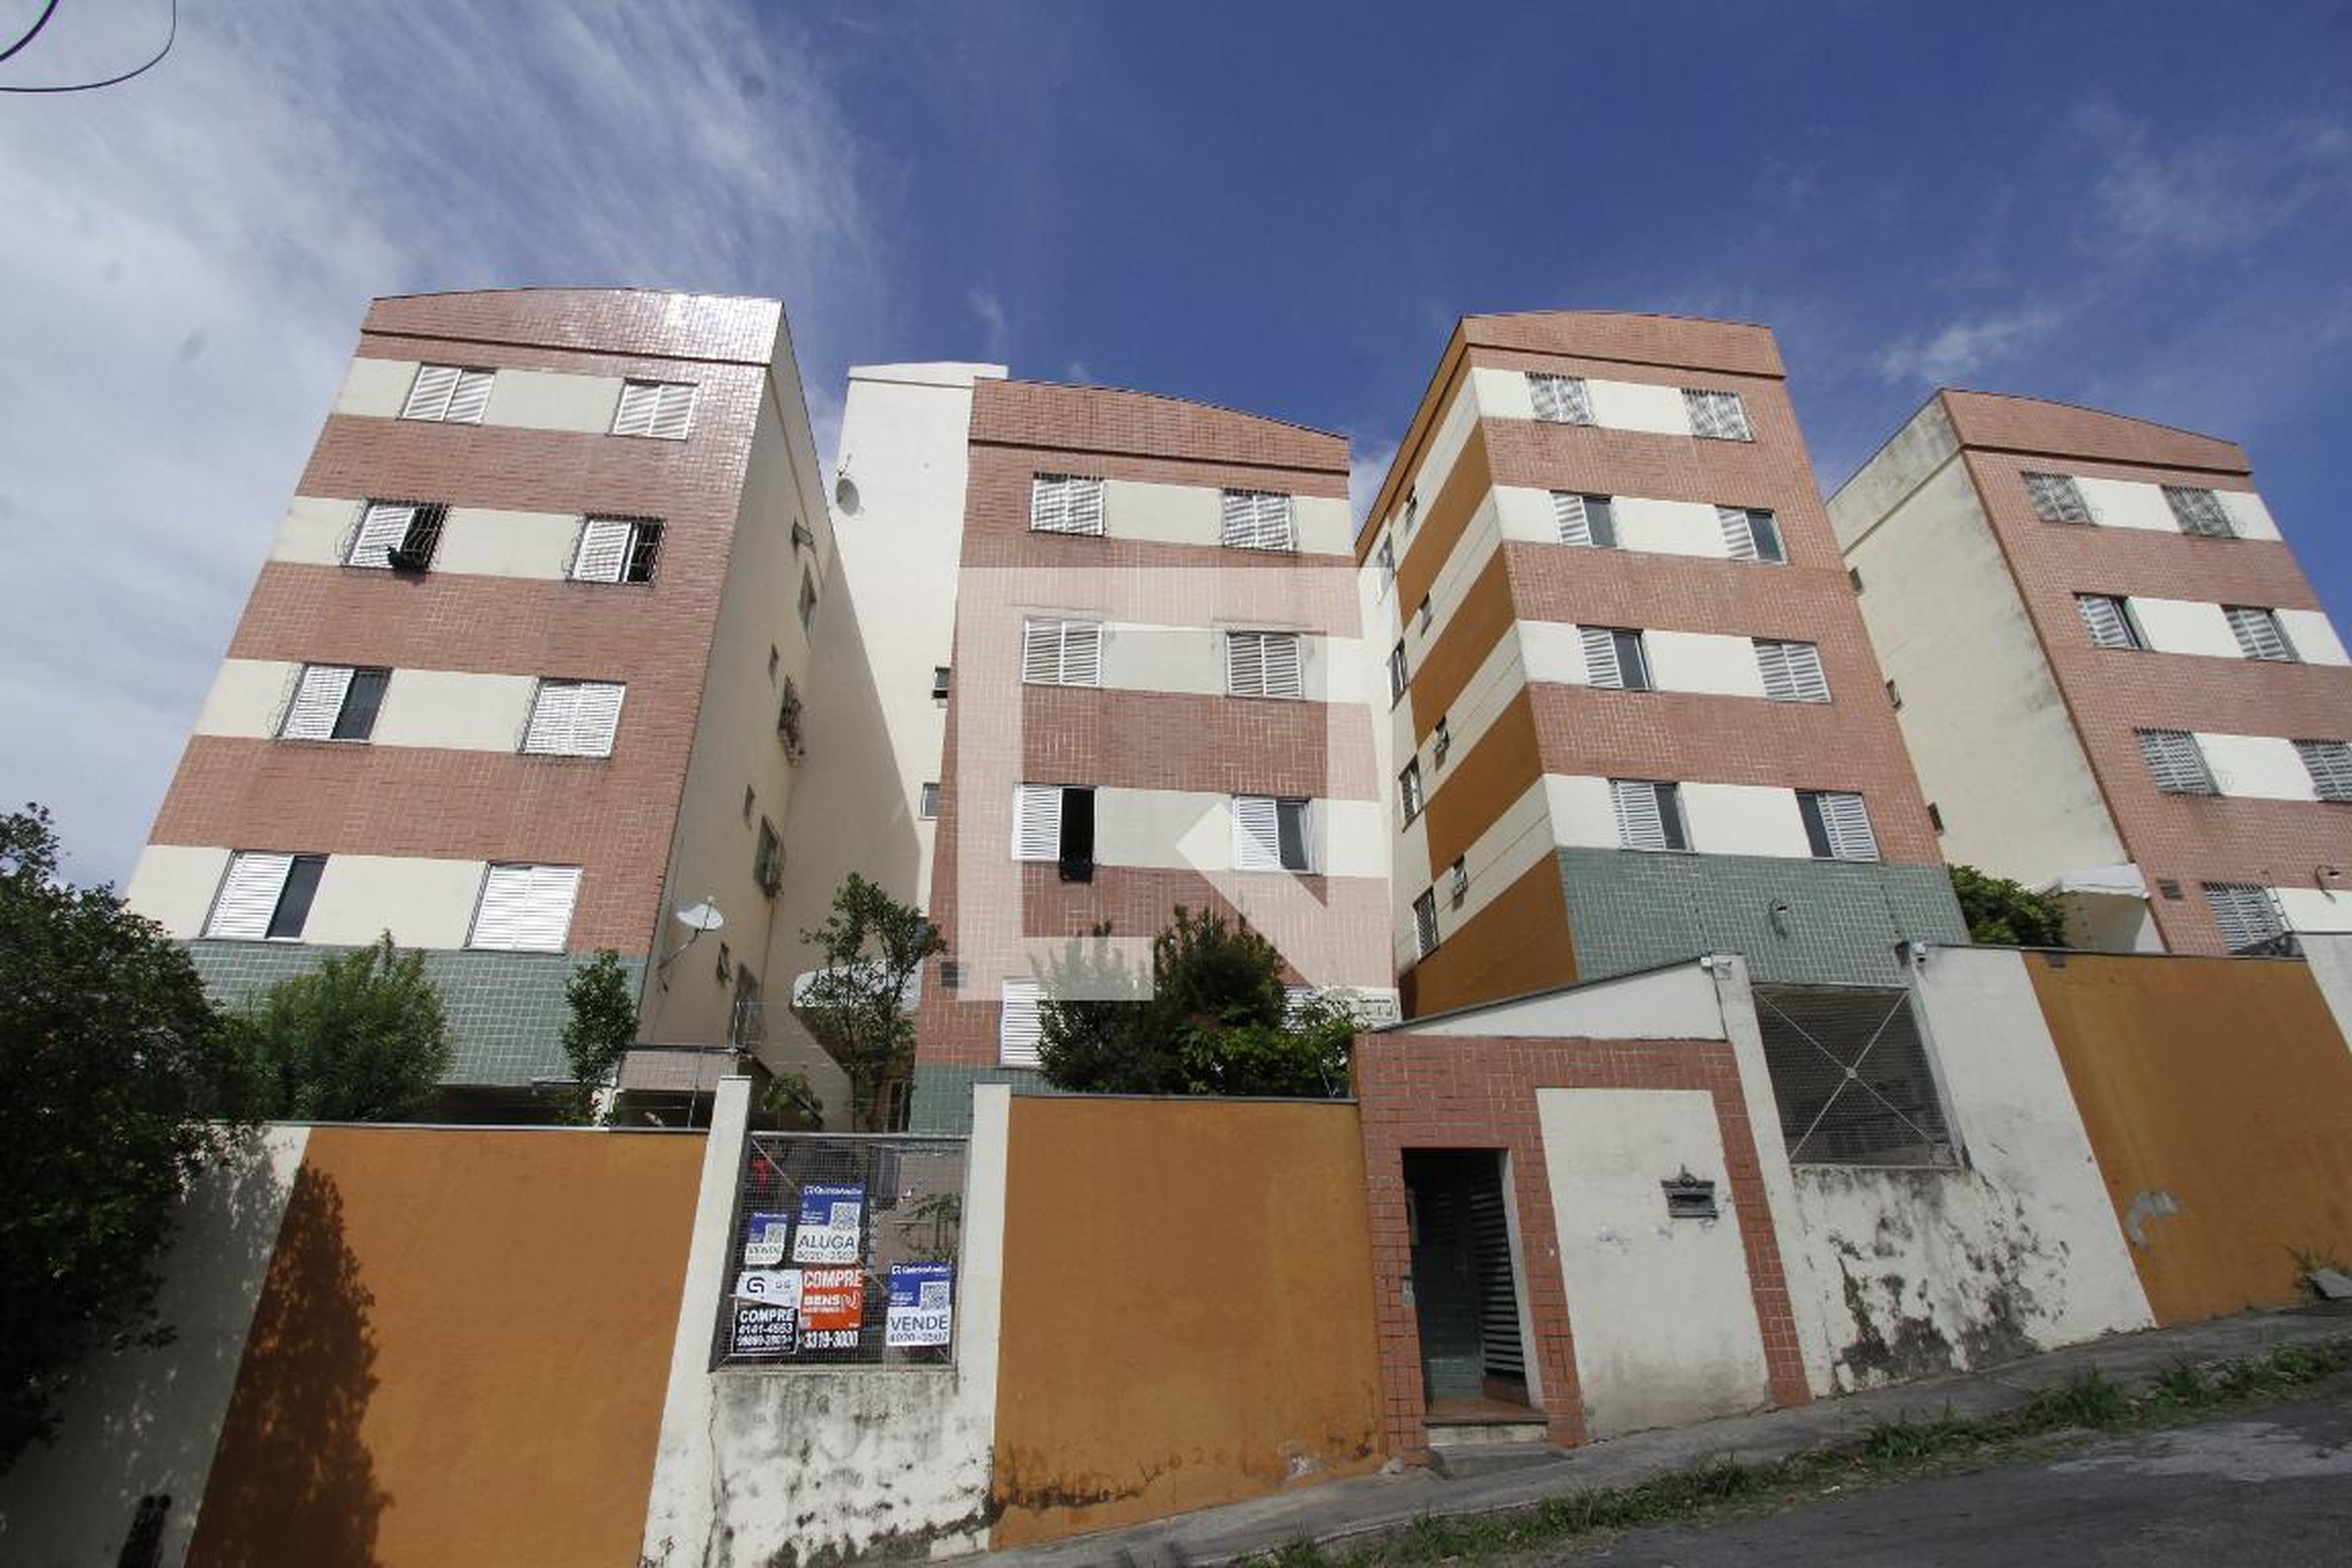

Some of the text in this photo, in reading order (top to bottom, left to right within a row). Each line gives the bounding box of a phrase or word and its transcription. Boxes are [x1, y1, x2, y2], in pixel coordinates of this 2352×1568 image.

[797, 1235, 856, 1250] ALUGA
[804, 1269, 863, 1288] COMPRE
[740, 1308, 795, 1323] COMPRE
[889, 1314, 948, 1331] VENDE
